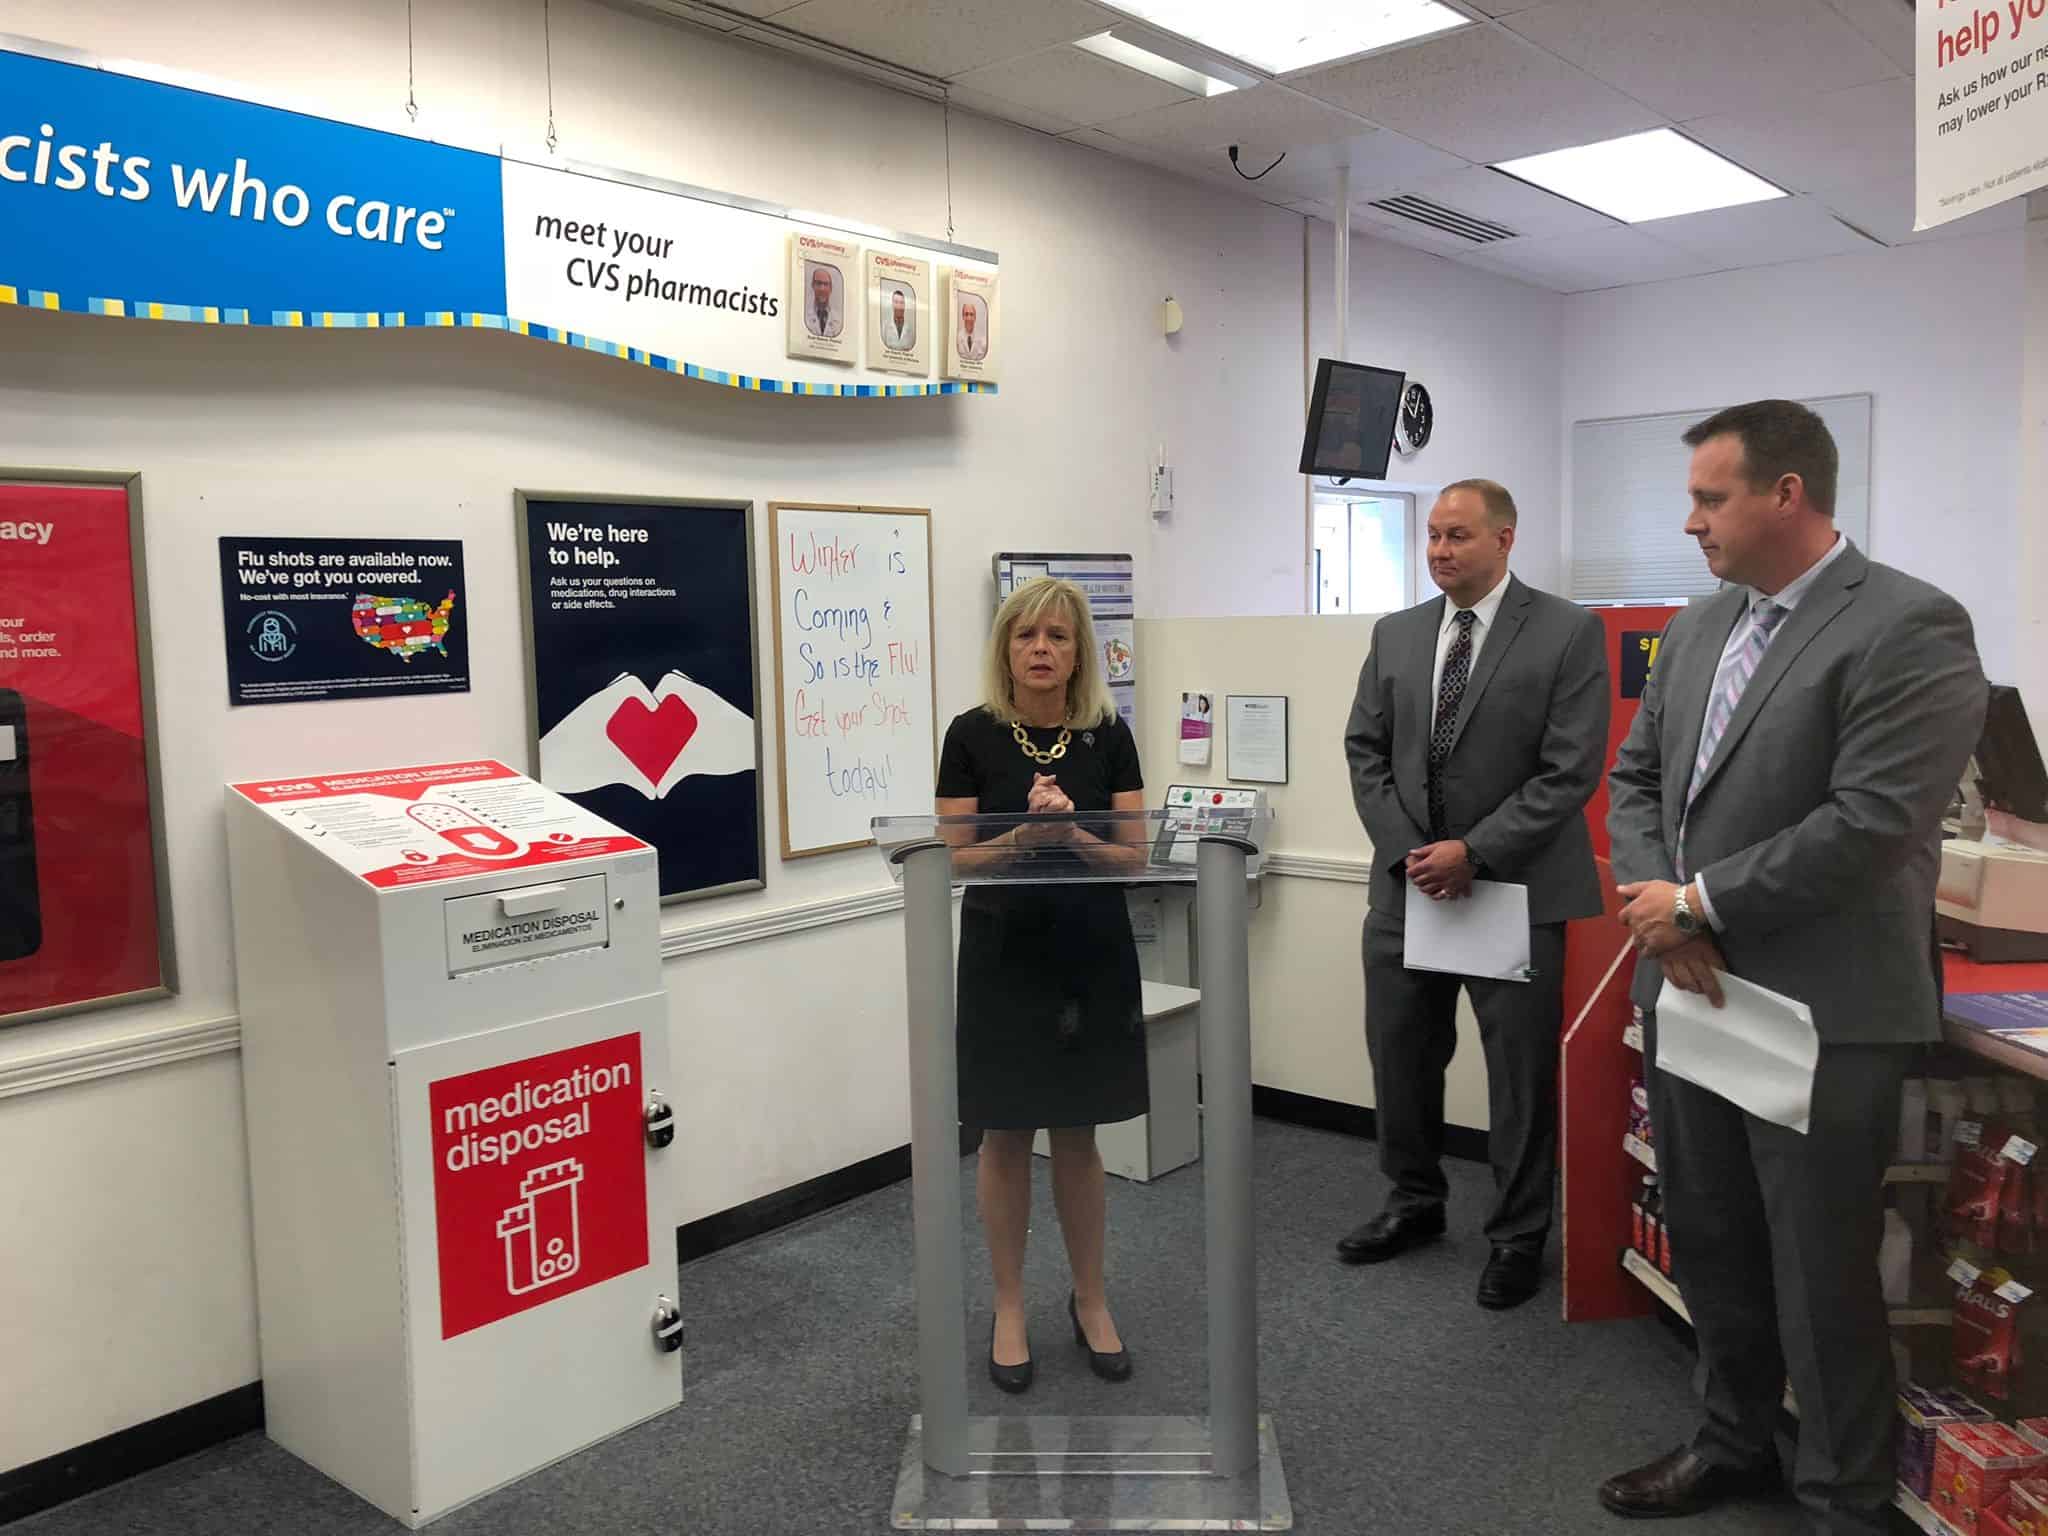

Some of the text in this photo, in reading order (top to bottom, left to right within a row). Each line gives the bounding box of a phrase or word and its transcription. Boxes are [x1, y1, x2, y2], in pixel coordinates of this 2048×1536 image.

[1938, 0, 2048, 68] help yo
[1937, 44, 2048, 110] Ask us how our ne
[1938, 113, 1964, 136] may
[1966, 97, 2000, 123] lower
[2003, 80, 2033, 110] your
[0, 124, 151, 201] cists
[170, 158, 310, 228] who
[326, 194, 446, 250] care
[535, 207, 674, 260] meet your
[566, 257, 779, 319] CVS pharmacists
[0, 521, 54, 545] acy
[547, 522, 649, 543] We're here
[790, 527, 906, 581] Winter is
[238, 551, 453, 567] Flu shots are available now.
[238, 569, 422, 587] We've got you covered.
[548, 547, 620, 568] to help.
[550, 576, 656, 588] Ask us your questions on
[550, 587, 676, 599] medications, drug interactions
[551, 599, 616, 609] or side effects.
[0, 618, 25, 628] our
[0, 631, 57, 644] ls, order
[794, 588, 871, 650] Coming
[0, 647, 62, 658] nd more.
[799, 640, 920, 687] So is the Flu!
[794, 688, 912, 741] Get your Shot
[826, 746, 892, 800] today!
[462, 909, 601, 945] MEDICATION DISPOSAL
[444, 1062, 631, 1134] medication
[446, 1102, 590, 1172] disposal
